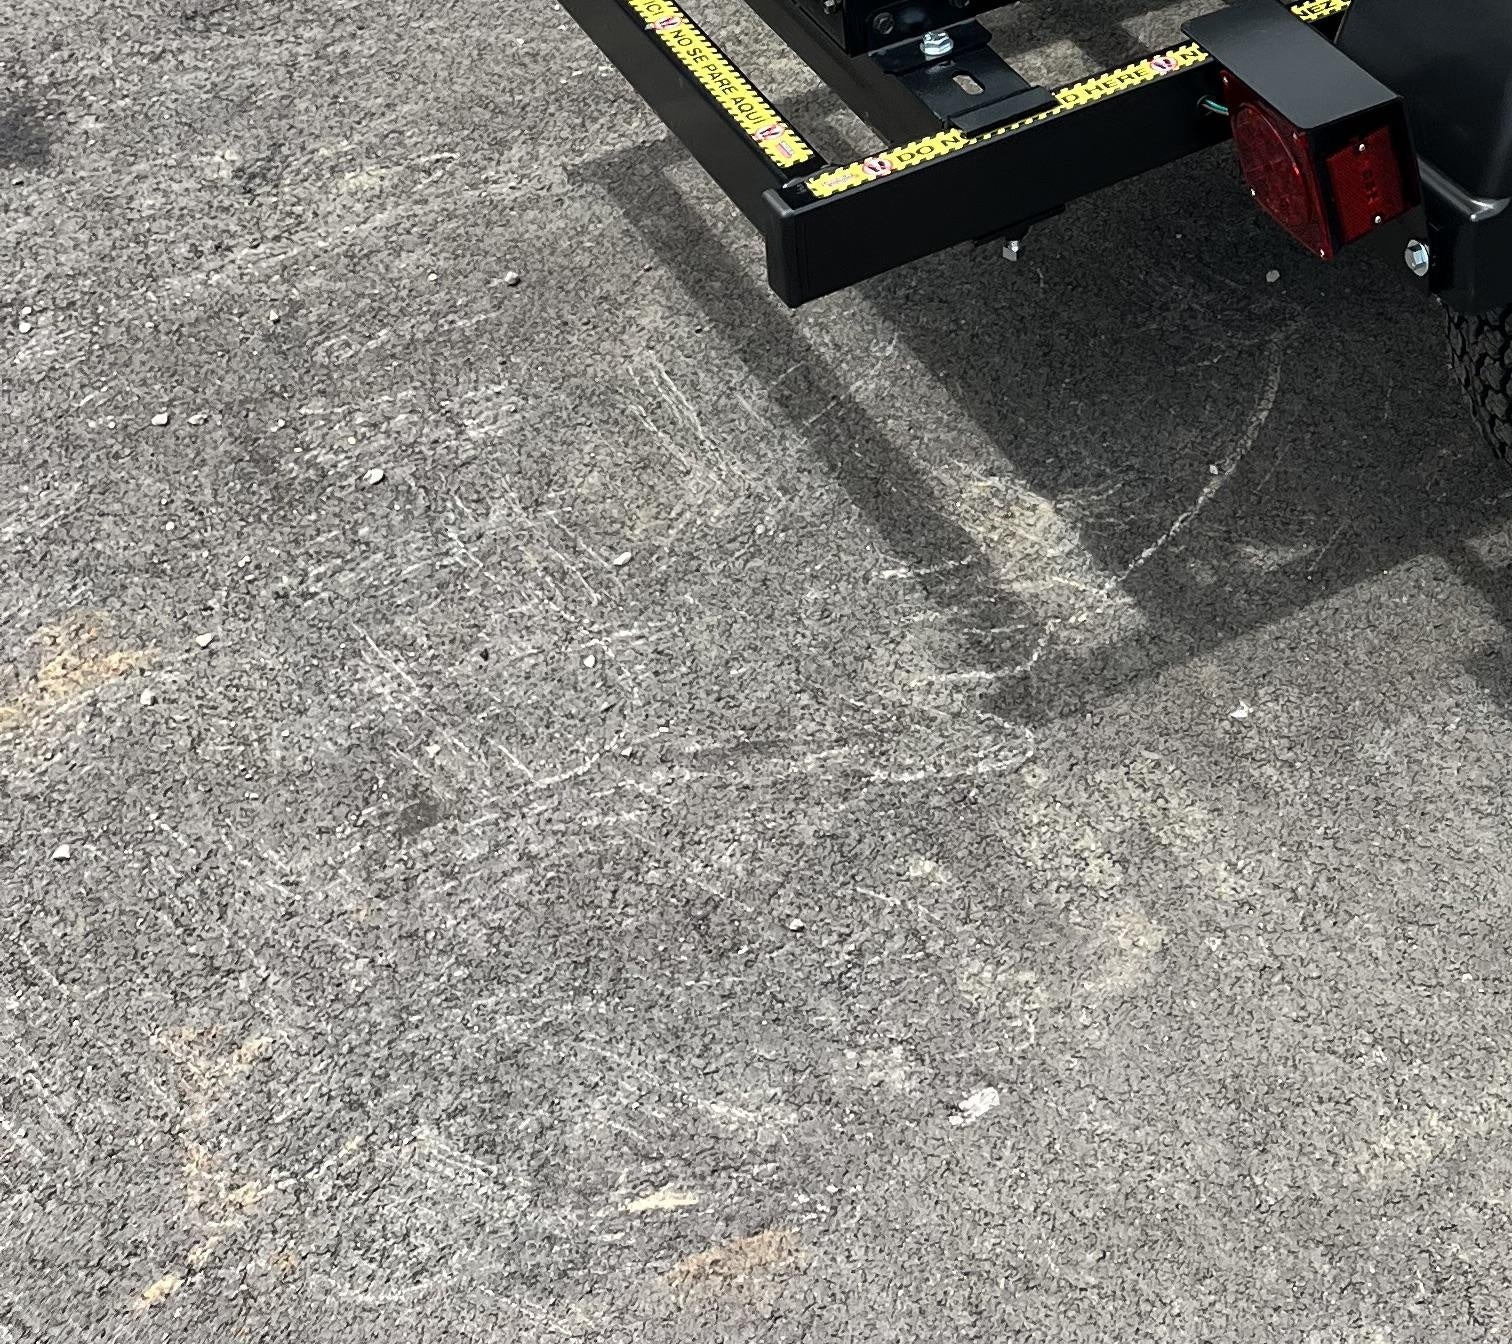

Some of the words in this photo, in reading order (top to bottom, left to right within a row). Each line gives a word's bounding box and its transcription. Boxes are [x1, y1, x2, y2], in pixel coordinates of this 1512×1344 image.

[643, 0, 666, 17] ICI
[669, 29, 692, 47] NO
[686, 47, 710, 64] SE
[702, 63, 740, 96] PARE
[731, 96, 768, 125] AQUI
[1084, 67, 1151, 96] HERE
[896, 145, 935, 164] DO
